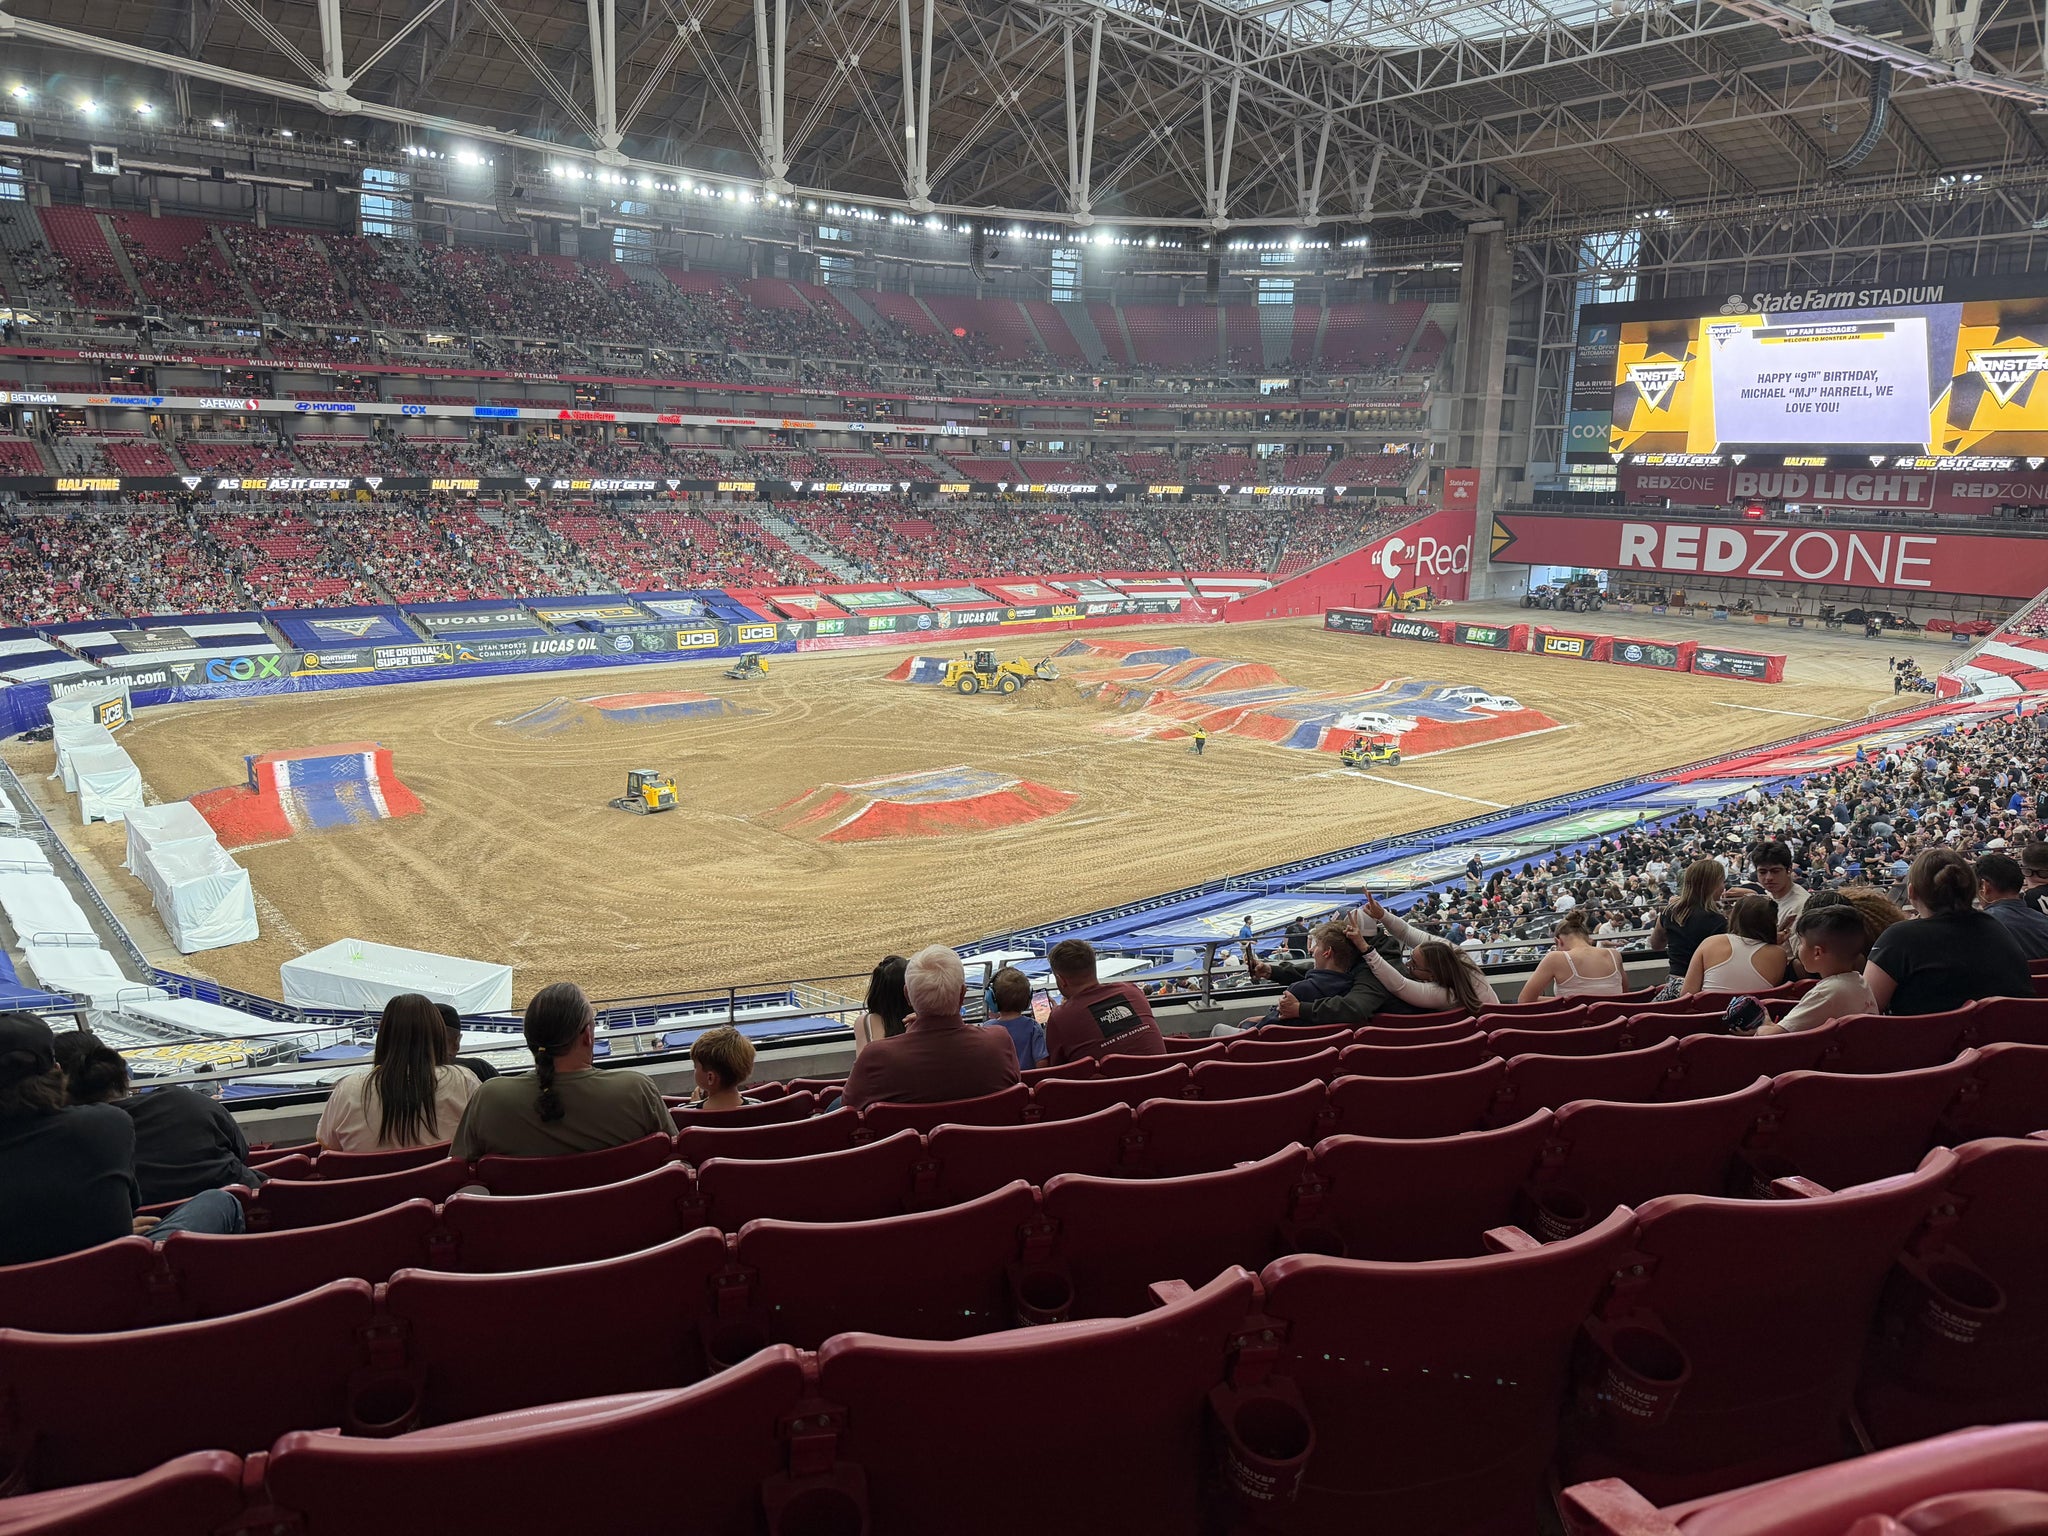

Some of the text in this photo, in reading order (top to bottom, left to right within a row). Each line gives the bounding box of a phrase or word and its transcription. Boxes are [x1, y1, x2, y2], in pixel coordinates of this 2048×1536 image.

[1858, 285, 1944, 306] STADIUM
[1785, 325, 1857, 336] VIP FAN MESSAGES
[78, 351, 122, 360] CHARLES
[248, 359, 286, 368] WILLIAM
[298, 361, 332, 370] BIDWILL
[528, 372, 558, 380] TILLMAN
[1625, 369, 1686, 382] MONSTER
[1757, 371, 1792, 384] HAPPY
[1823, 370, 1879, 383] BIRTHDAY,
[10, 393, 58, 403] BETMGM
[1740, 388, 1786, 399] MICHAEL
[1820, 386, 1873, 399] HARRELL,
[1875, 385, 1894, 397] WE
[199, 398, 245, 410] SAFEWAY
[312, 402, 357, 412] HYUNDAI
[401, 405, 426, 415] COX
[1785, 401, 1840, 413] LOVE YOU!
[940, 426, 970, 435] AVNET
[1572, 424, 1608, 439] COX
[1631, 455, 1646, 464] AS
[1647, 455, 1664, 464] BIG
[1664, 456, 1678, 464] AS
[1783, 457, 1828, 466] HALFTIME
[1895, 458, 1911, 467] AS
[1914, 458, 1937, 467] BIG
[1940, 459, 1955, 467] AS
[1956, 459, 1970, 468] IT
[56, 478, 121, 491] HALFTIME
[217, 478, 350, 490] AS BIG AS IT GETS!
[432, 479, 479, 490] HALFTIME
[552, 479, 657, 490] AS BIG AS IT GETS!
[718, 482, 756, 492] HALFTIME
[811, 482, 892, 492] AS BIG AS IT GETS!
[939, 483, 970, 493] HALFTIME
[1015, 484, 1029, 492] AS
[1030, 484, 1045, 492] BIG
[1046, 484, 1059, 493] AS
[1636, 475, 1715, 491] REDZONE
[1735, 472, 1928, 502] BUD LIGHT
[1148, 485, 1184, 494] HALFTIME
[1238, 486, 1253, 494] AS
[1254, 486, 1270, 494] BIG
[1270, 487, 1284, 495] AS
[1415, 534, 1472, 577] Red
[1618, 523, 1938, 588] REDZONE
[1051, 605, 1077, 616] UNOH
[425, 613, 528, 627] LUCAS OIL
[868, 616, 896, 630] BKT
[957, 613, 986, 624] LUCAS
[816, 620, 844, 633] BKT
[1391, 622, 1422, 636] LUCAS
[681, 633, 716, 646] JCB
[742, 627, 775, 642] JCB
[1467, 627, 1496, 642] BKT
[499, 642, 527, 650] SPORTS
[532, 638, 575, 654] LUCAS
[1547, 640, 1581, 653] JCB
[376, 646, 437, 659] THE ORIGINAL
[479, 649, 527, 658] COMMISSION
[376, 654, 435, 667] SUPER GLUE
[205, 655, 282, 682] COX
[103, 703, 122, 725] JCB
[1100, 1033, 1128, 1048] NEVER STOP
[1625, 1385, 1659, 1402] RIVER
